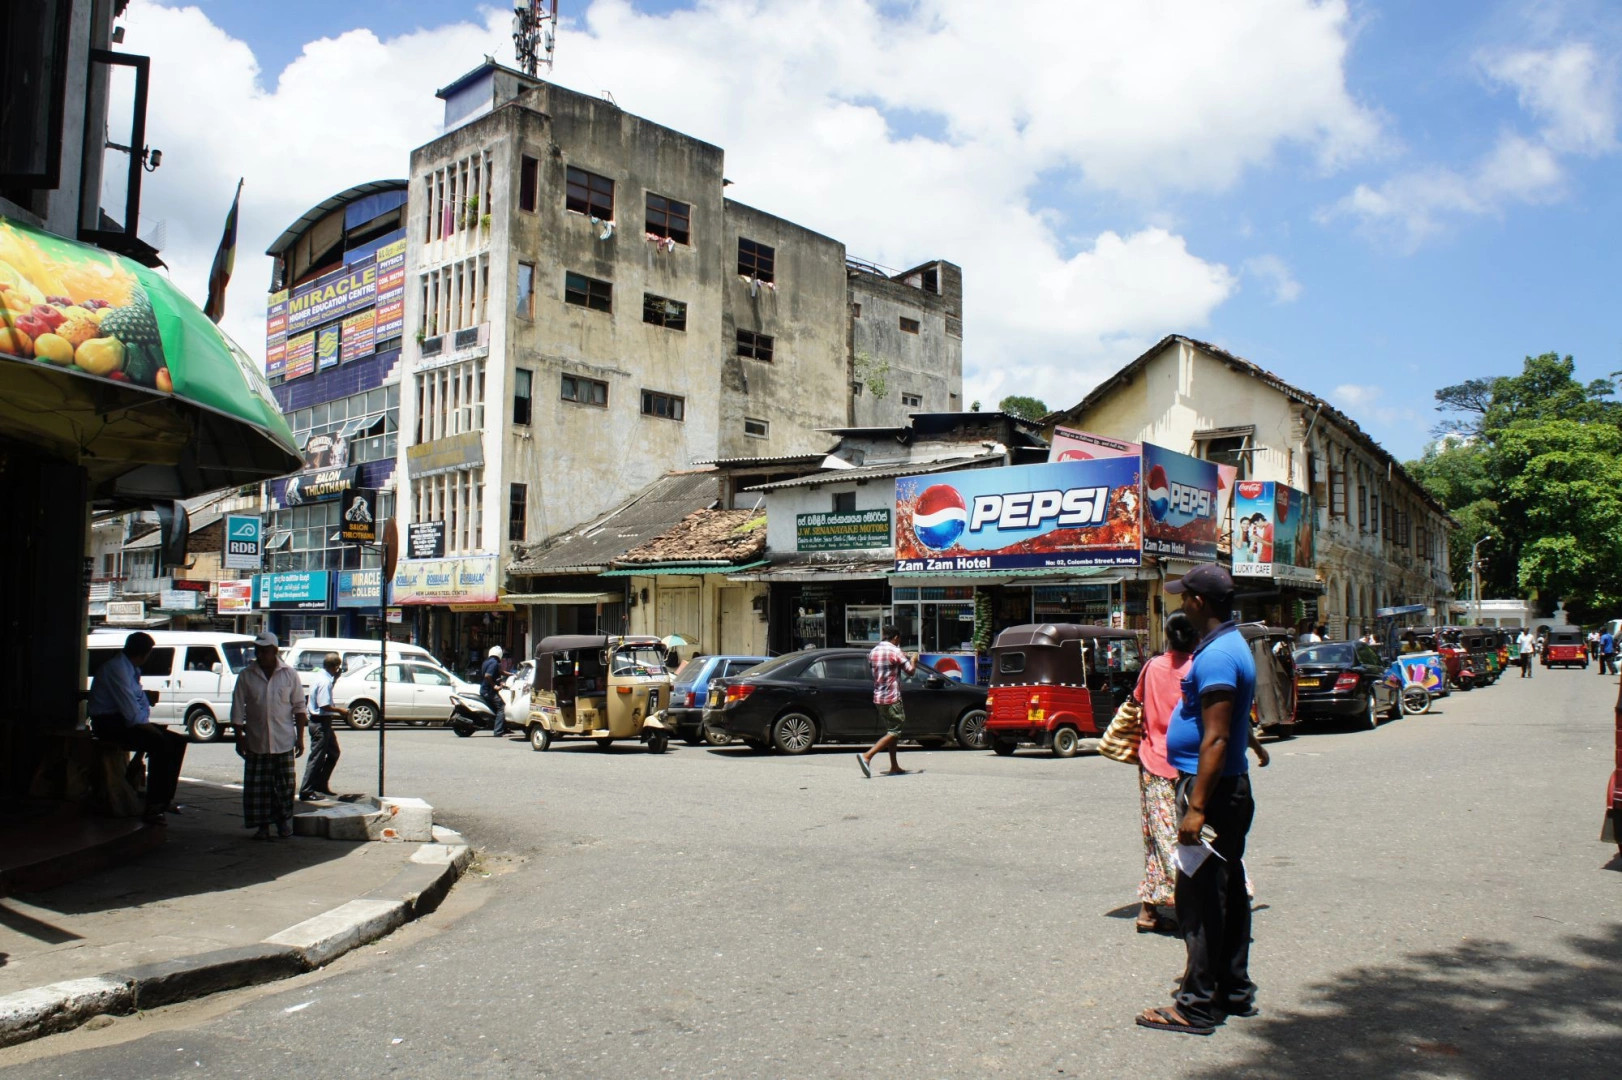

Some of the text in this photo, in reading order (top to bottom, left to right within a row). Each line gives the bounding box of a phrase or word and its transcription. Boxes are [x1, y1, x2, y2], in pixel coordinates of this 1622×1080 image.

[380, 254, 403, 269] PHYSICS
[289, 267, 375, 315] MIRACLE
[378, 286, 403, 302] CHEMISTRY
[289, 306, 311, 323] HIGHER
[312, 294, 347, 316] EDUCATION
[349, 283, 375, 300] CENTRE
[380, 303, 400, 314] BIOLOGY
[316, 470, 341, 484] SALON
[305, 479, 351, 497] THILOTHAMA
[1238, 483, 1261, 492] Coca-Cola
[1169, 482, 1212, 517] PEPSI
[971, 487, 1109, 531] PEPSI
[349, 523, 369, 531] SALON
[812, 525, 858, 535] SENANAYAKE
[859, 523, 888, 533] MOTORS
[342, 531, 375, 540] THILOTHAMA
[230, 542, 257, 554] RDB
[1144, 538, 1157, 550] Zam
[1158, 541, 1171, 552] Zam
[1172, 543, 1186, 554] Hotel
[898, 557, 991, 571] Zam Zam Hotel
[1116, 557, 1138, 565] Kandy.
[1235, 564, 1270, 575] LUCKY CAFE
[352, 572, 381, 586] MIRACLE
[351, 587, 380, 597] COLLEGE
